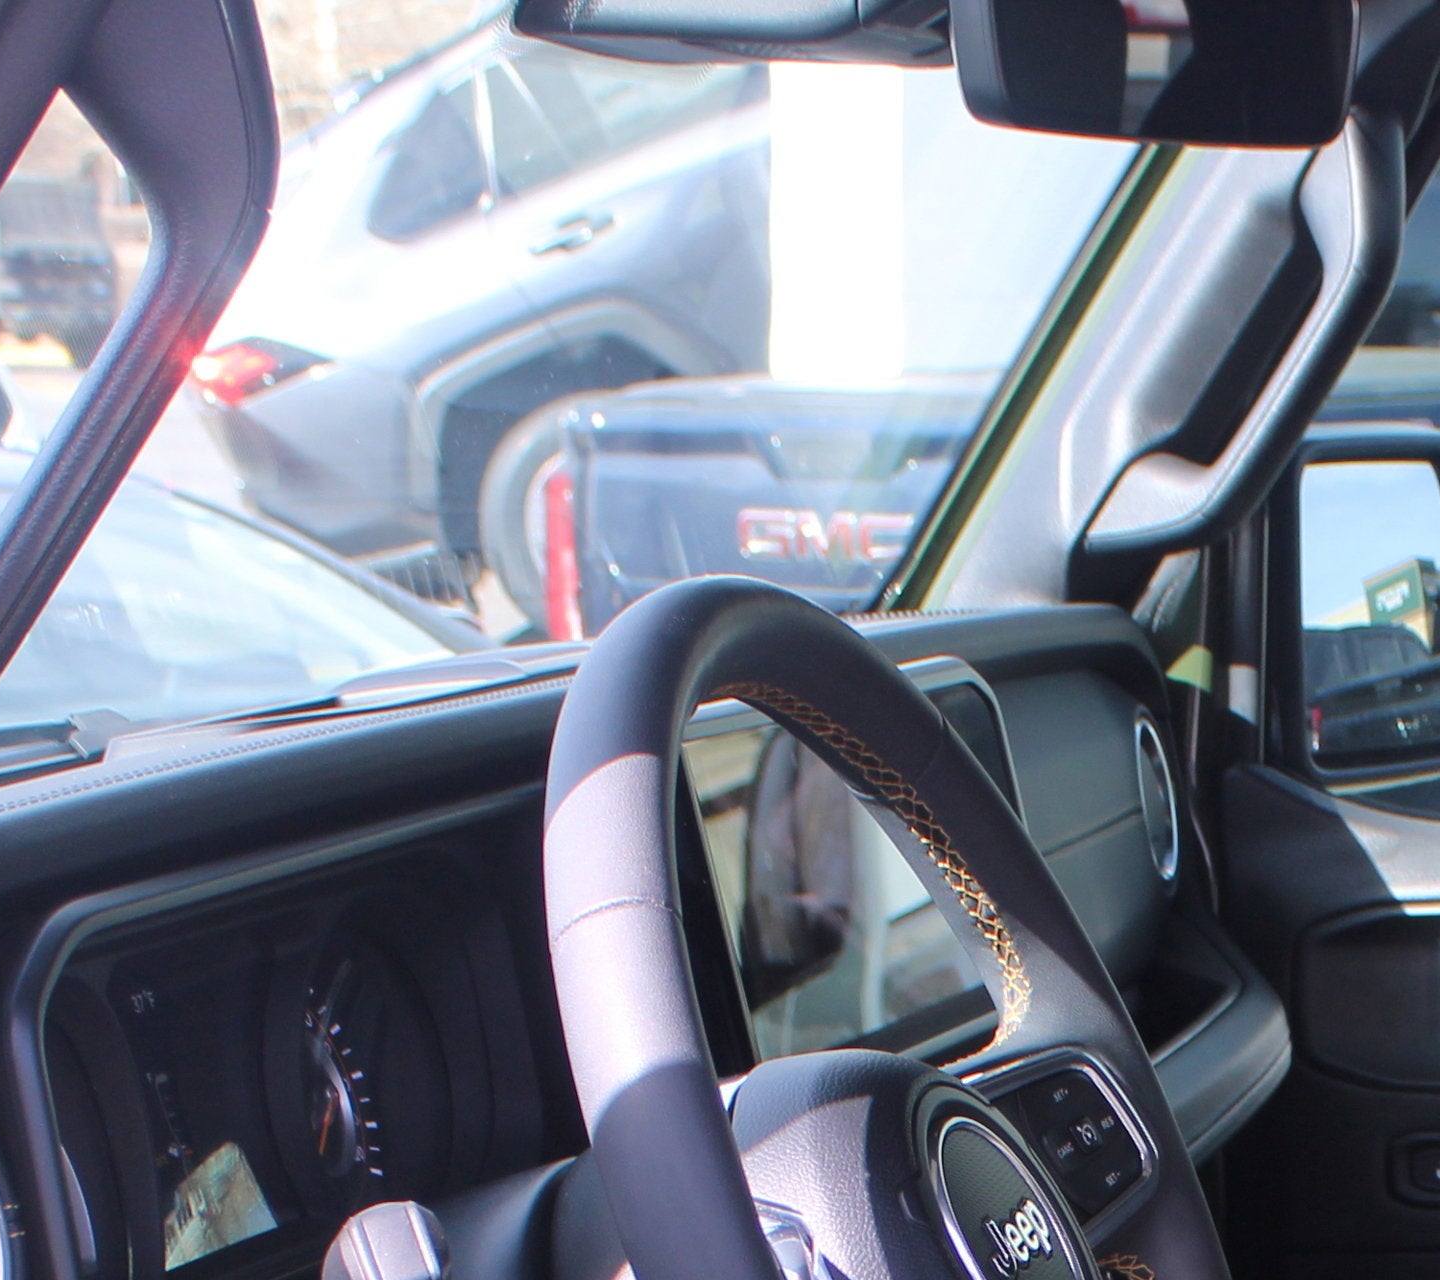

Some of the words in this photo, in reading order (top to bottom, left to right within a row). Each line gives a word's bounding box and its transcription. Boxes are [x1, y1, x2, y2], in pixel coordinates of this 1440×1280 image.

[737, 507, 915, 561] GMC
[1100, 1115, 1116, 1131] RES
[984, 1198, 1053, 1280] Jeep
